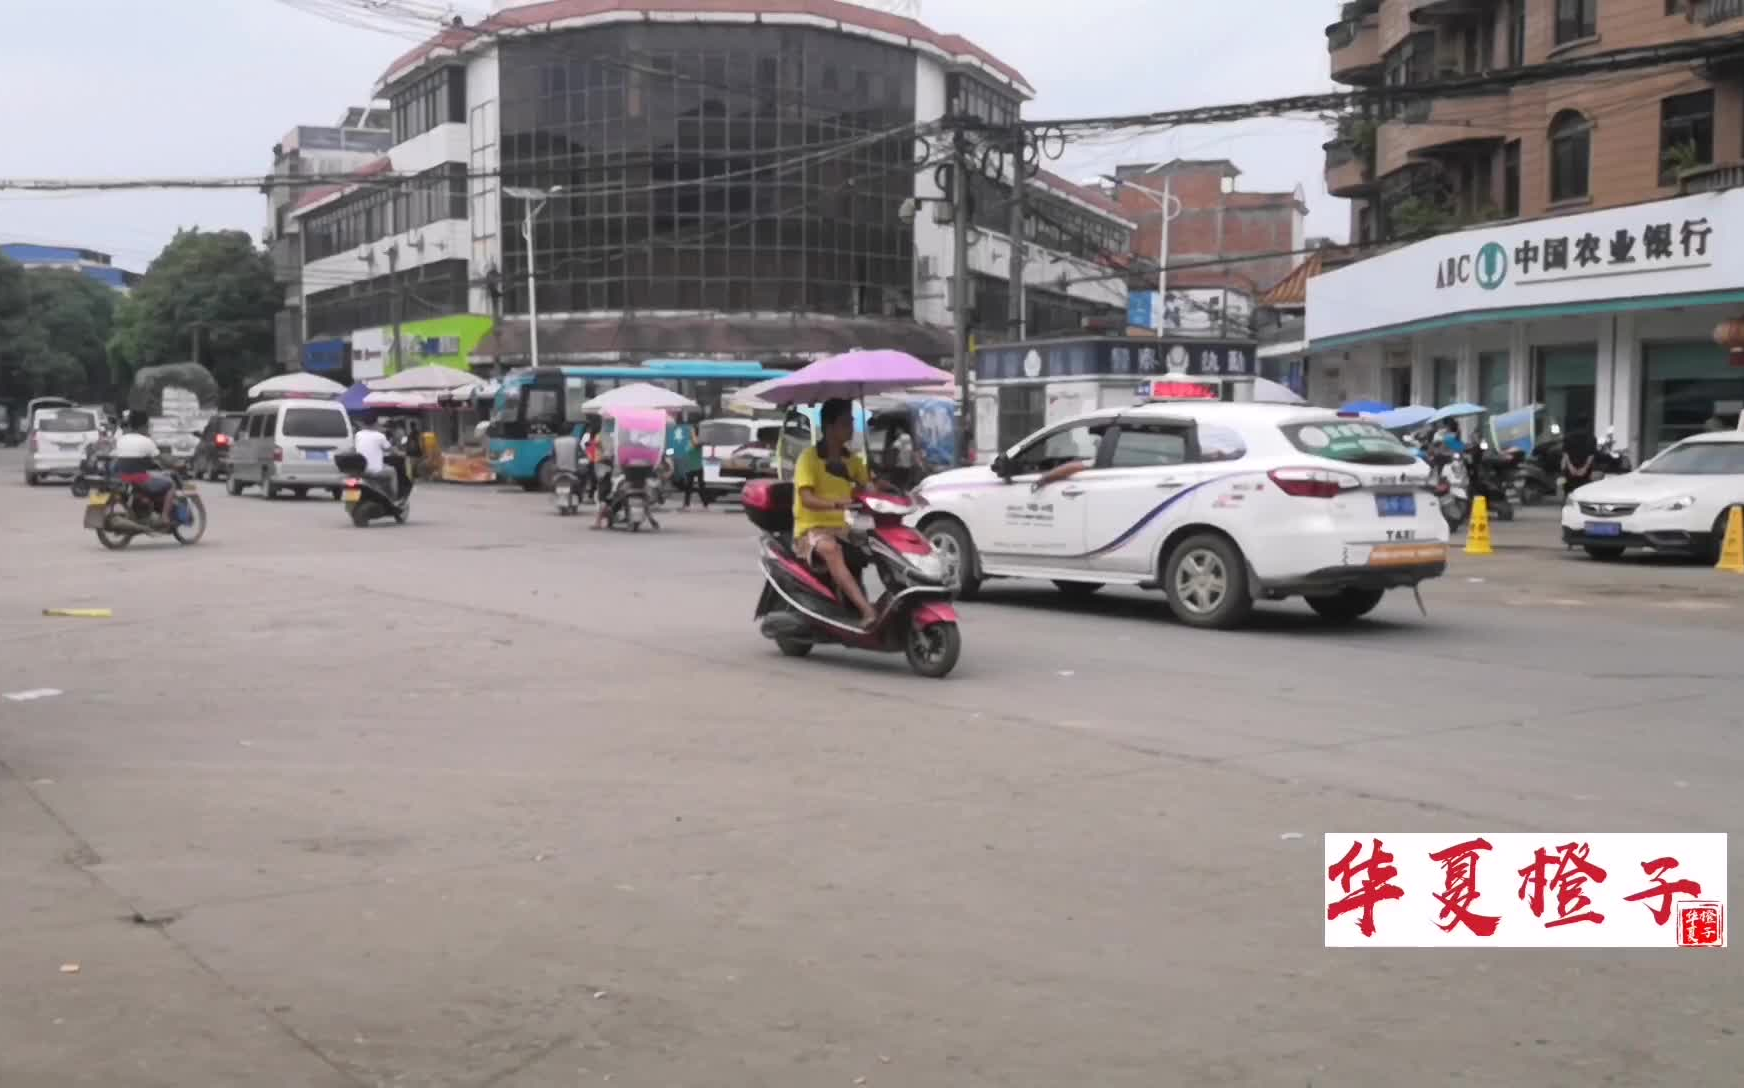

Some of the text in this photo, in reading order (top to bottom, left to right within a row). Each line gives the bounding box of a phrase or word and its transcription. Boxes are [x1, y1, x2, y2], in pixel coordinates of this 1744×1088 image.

[1514, 217, 1713, 275] 中国农业银行
[1435, 254, 1471, 289] ABC
